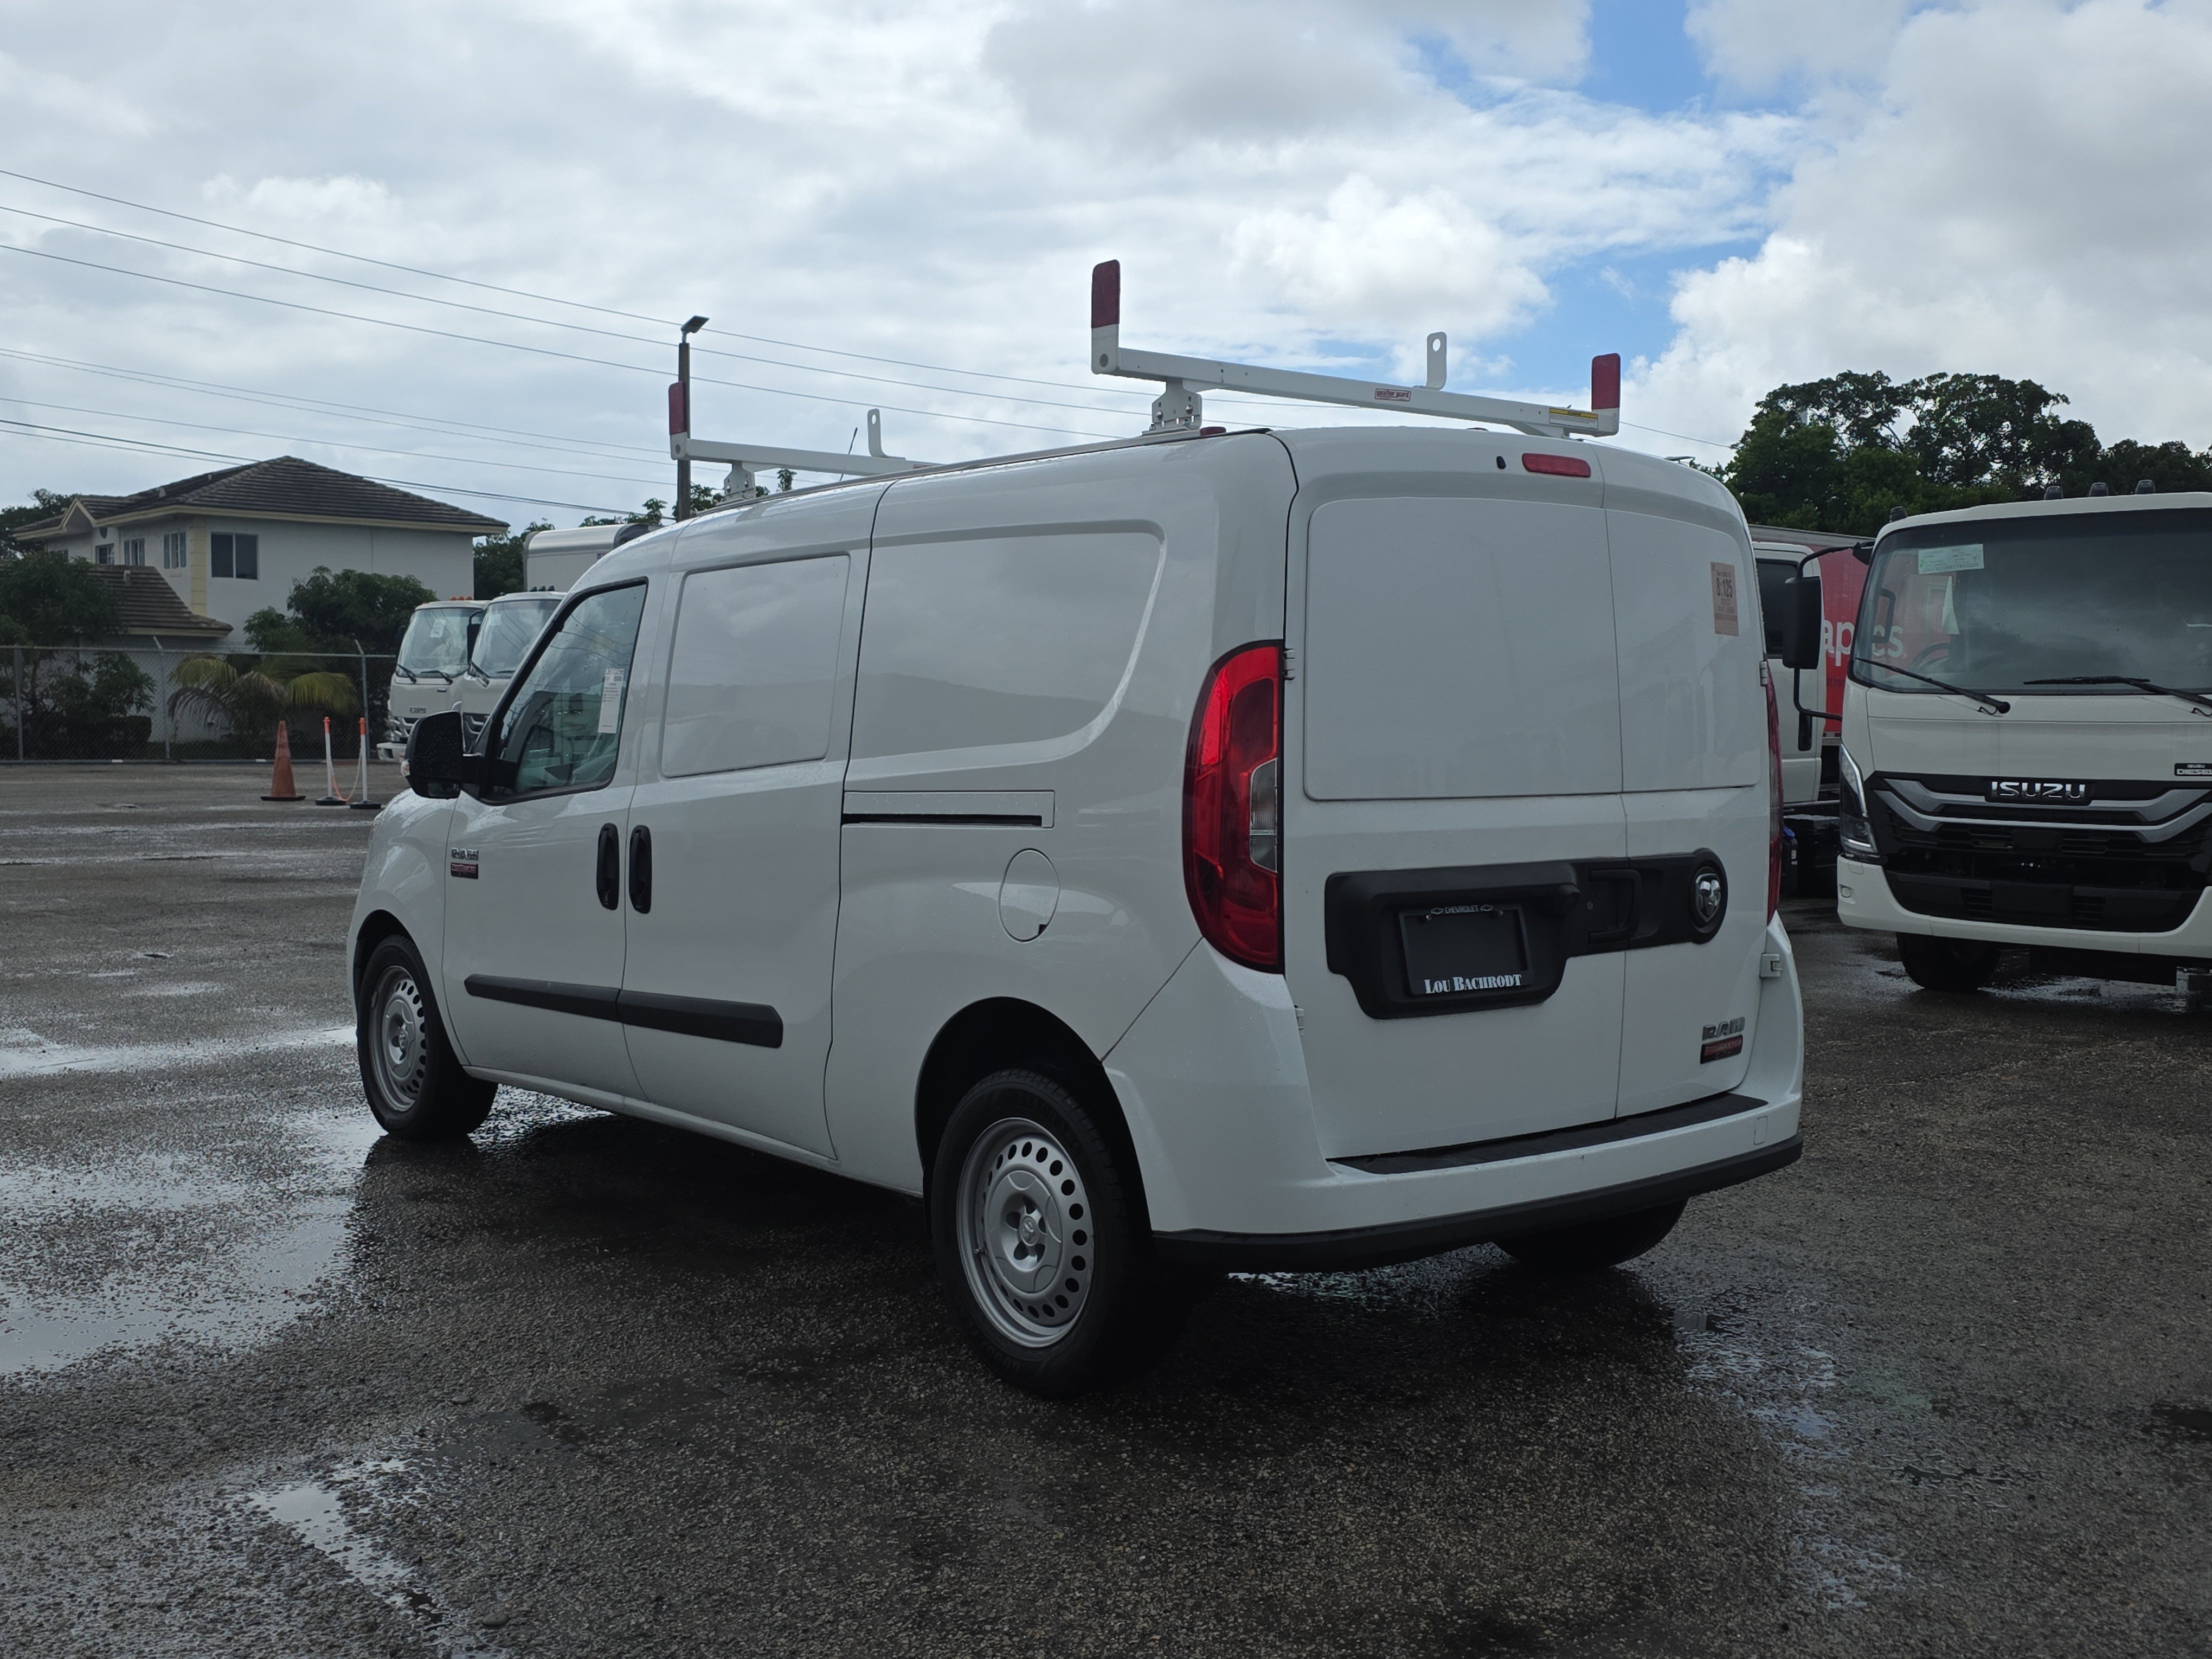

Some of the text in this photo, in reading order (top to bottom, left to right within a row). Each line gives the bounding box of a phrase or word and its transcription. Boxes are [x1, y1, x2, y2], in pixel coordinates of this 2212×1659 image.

[1824, 620, 1904, 666] apes
[1991, 781, 2086, 800] ISUZU
[1445, 905, 1478, 914] CHEVROLET
[1702, 1016, 1745, 1040] RAM
